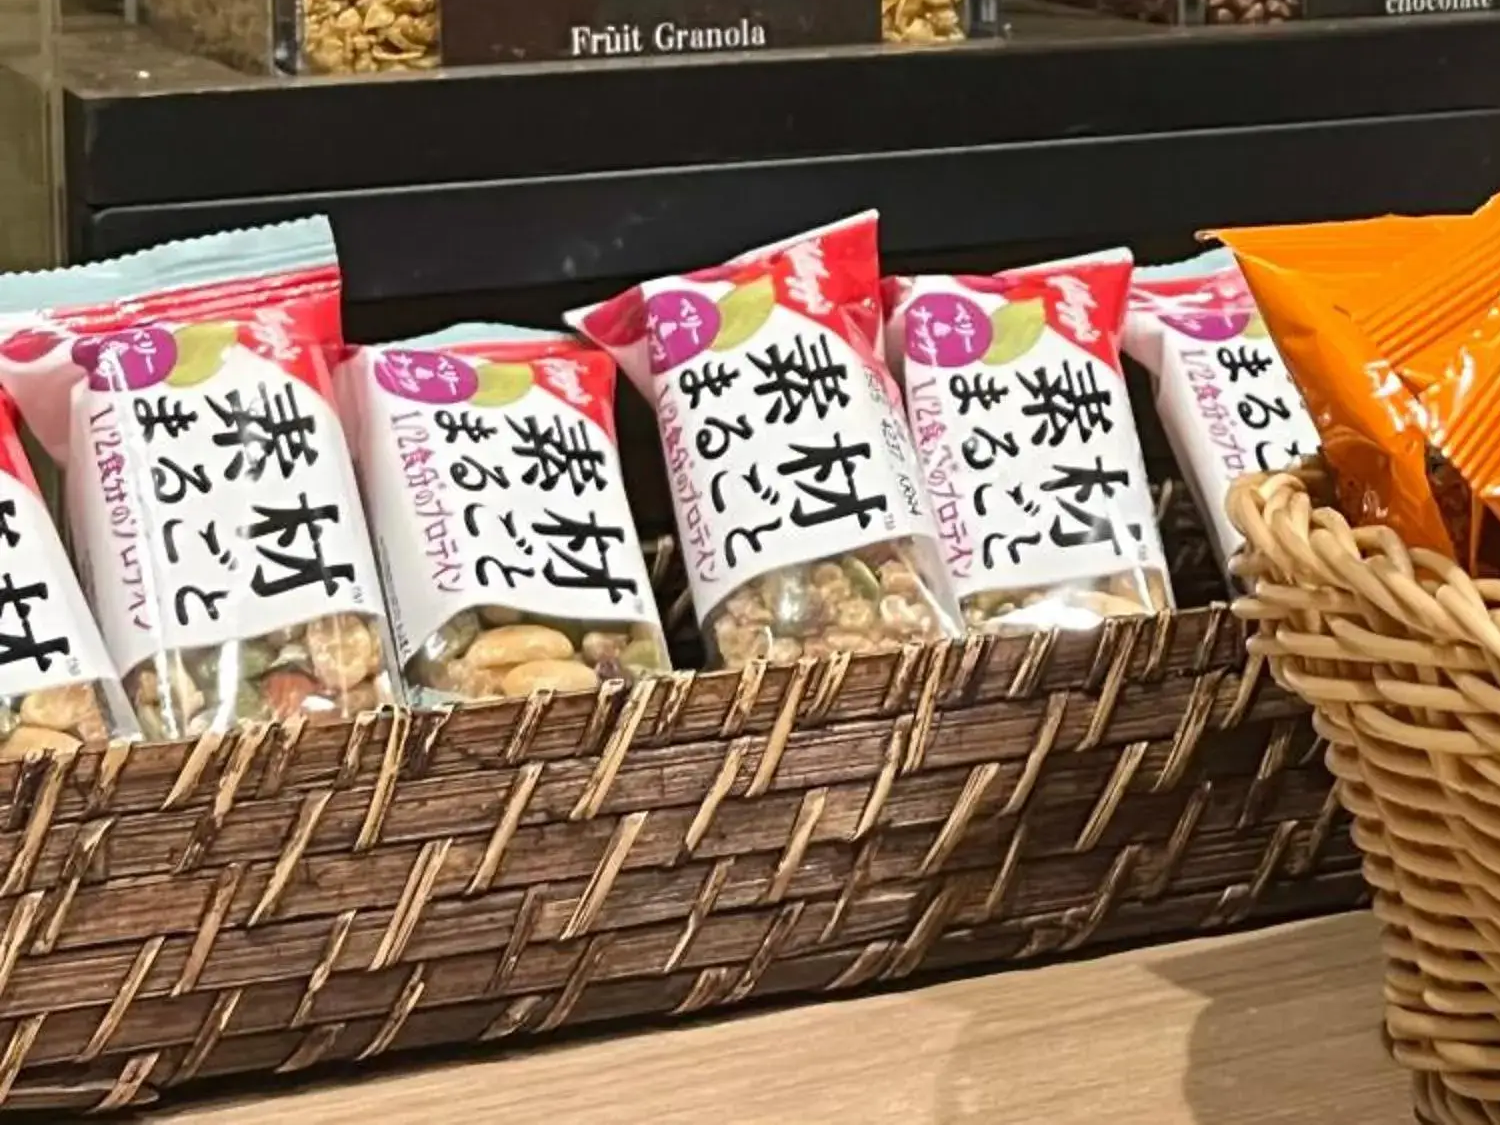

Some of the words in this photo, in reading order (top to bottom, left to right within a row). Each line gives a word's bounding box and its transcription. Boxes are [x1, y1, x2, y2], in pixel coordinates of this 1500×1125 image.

[570, 24, 644, 56] Fruit
[655, 20, 767, 53] Granola
[133, 394, 239, 627] まるごと
[203, 381, 356, 598] 素材
[433, 409, 535, 588] まるごと
[503, 414, 638, 604] 素材
[679, 361, 783, 568] まるごと
[746, 333, 888, 530] 素材
[949, 372, 1042, 570] まるごと
[1015, 360, 1142, 557] 素材
